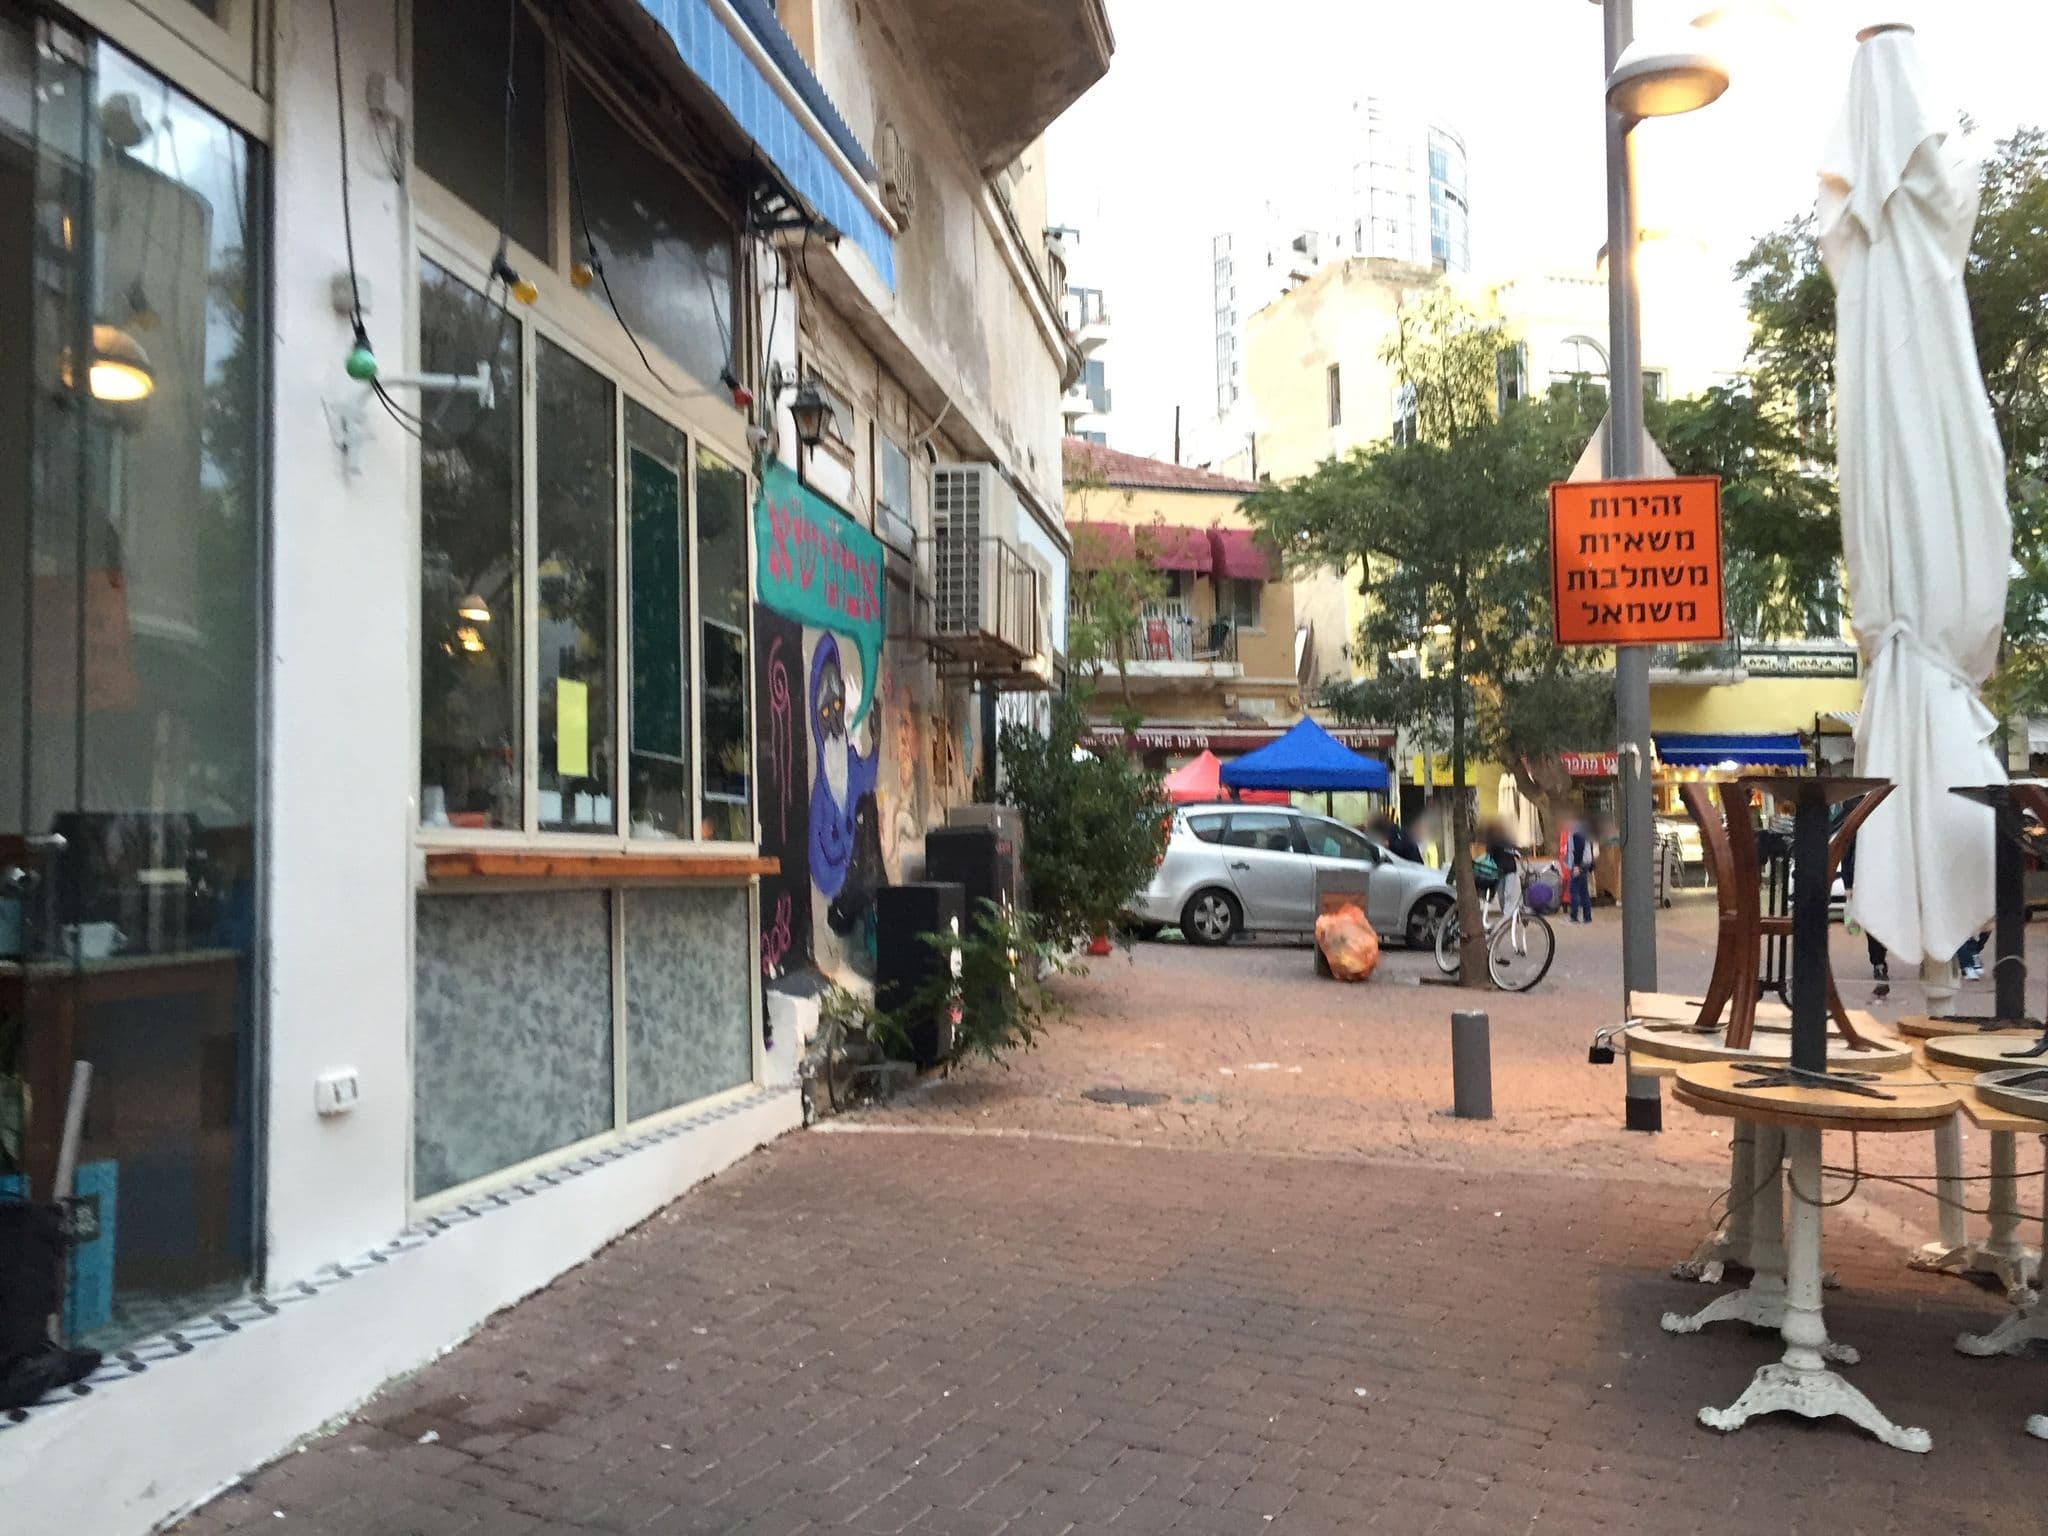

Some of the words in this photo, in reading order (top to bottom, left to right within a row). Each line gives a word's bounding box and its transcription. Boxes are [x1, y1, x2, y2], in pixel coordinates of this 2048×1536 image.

[1590, 495, 1682, 518] זהירות
[1579, 530, 1695, 554] משאיות
[1567, 563, 1708, 591] משתלבות
[1582, 601, 1696, 625] משמאל
